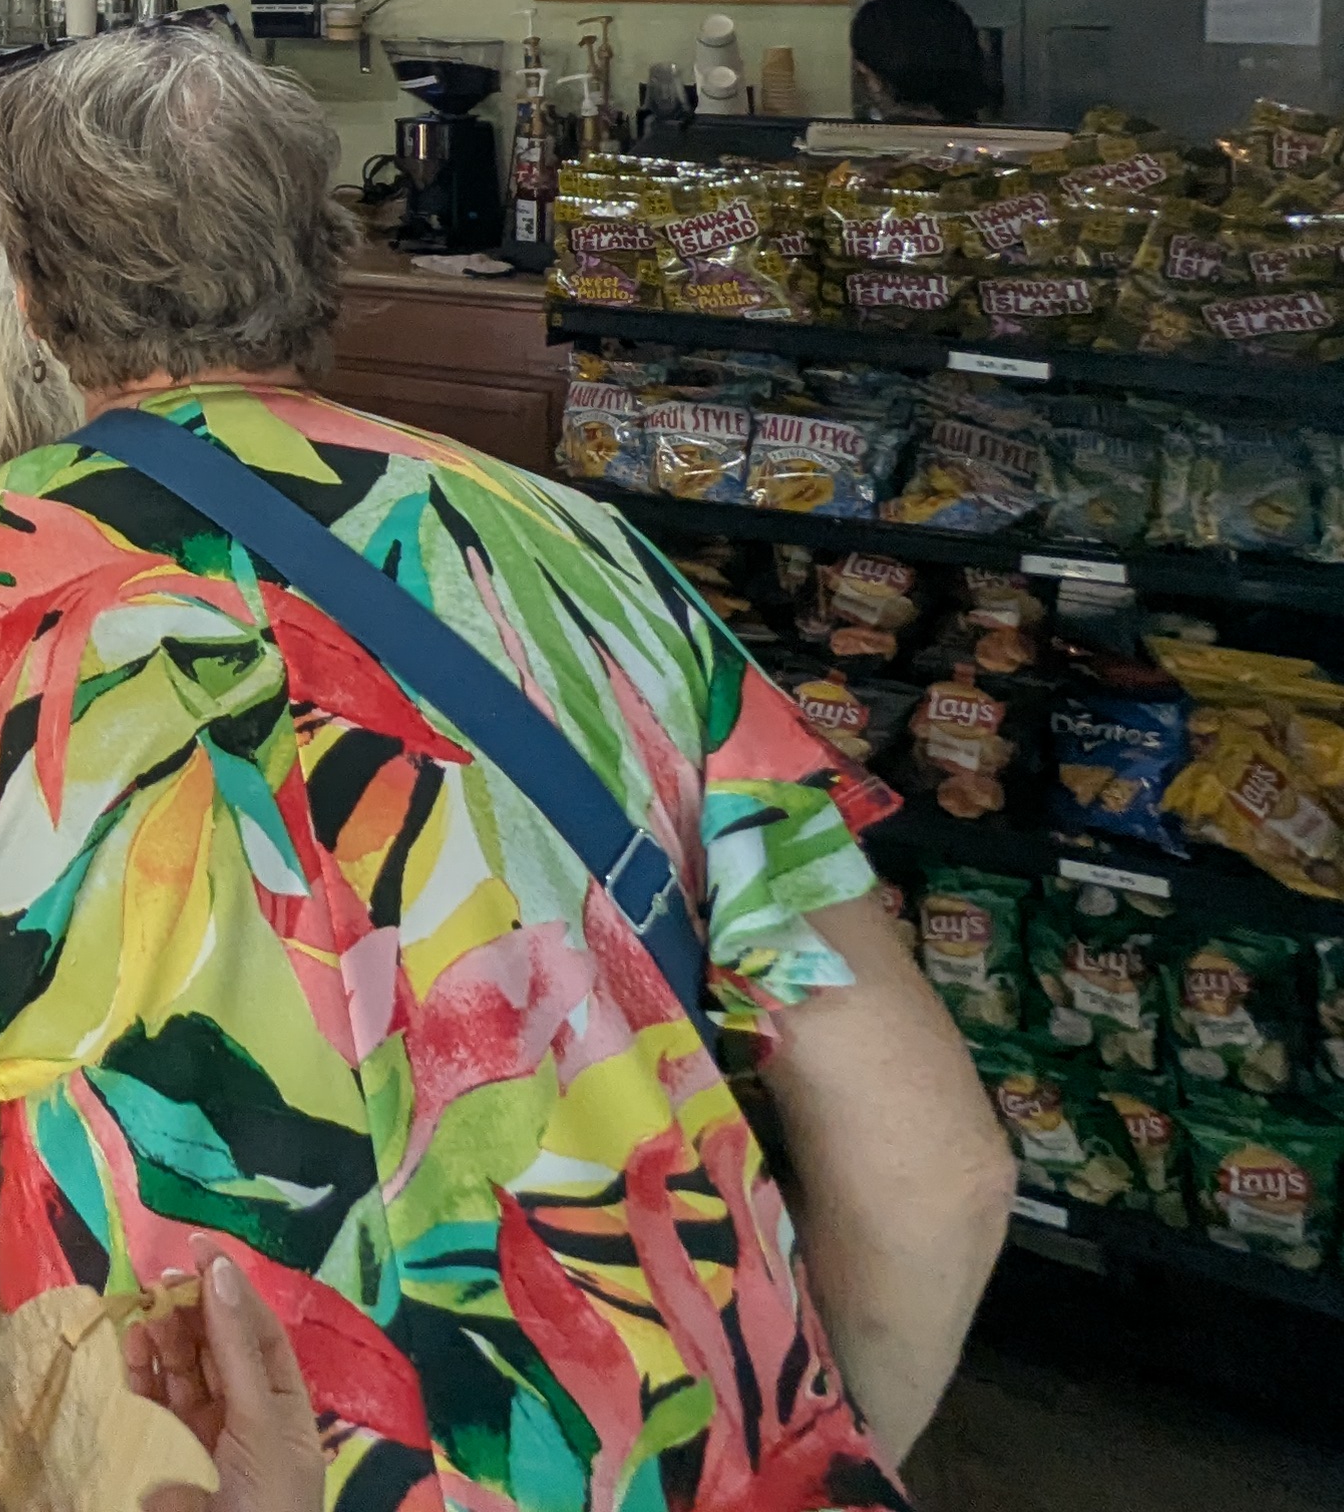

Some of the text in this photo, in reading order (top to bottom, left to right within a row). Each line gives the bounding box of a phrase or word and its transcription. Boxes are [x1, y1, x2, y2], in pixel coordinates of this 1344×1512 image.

[674, 221, 757, 254] ISLAND
[846, 235, 942, 255] ISLAND
[571, 275, 618, 287] Sweet
[688, 279, 740, 297] Sweet
[577, 288, 628, 300] Potato
[985, 299, 1091, 315] ISLAND
[692, 406, 749, 436] STYLE
[810, 422, 861, 456] STYLE
[843, 552, 909, 586] Lay's
[928, 690, 994, 726] Lay's
